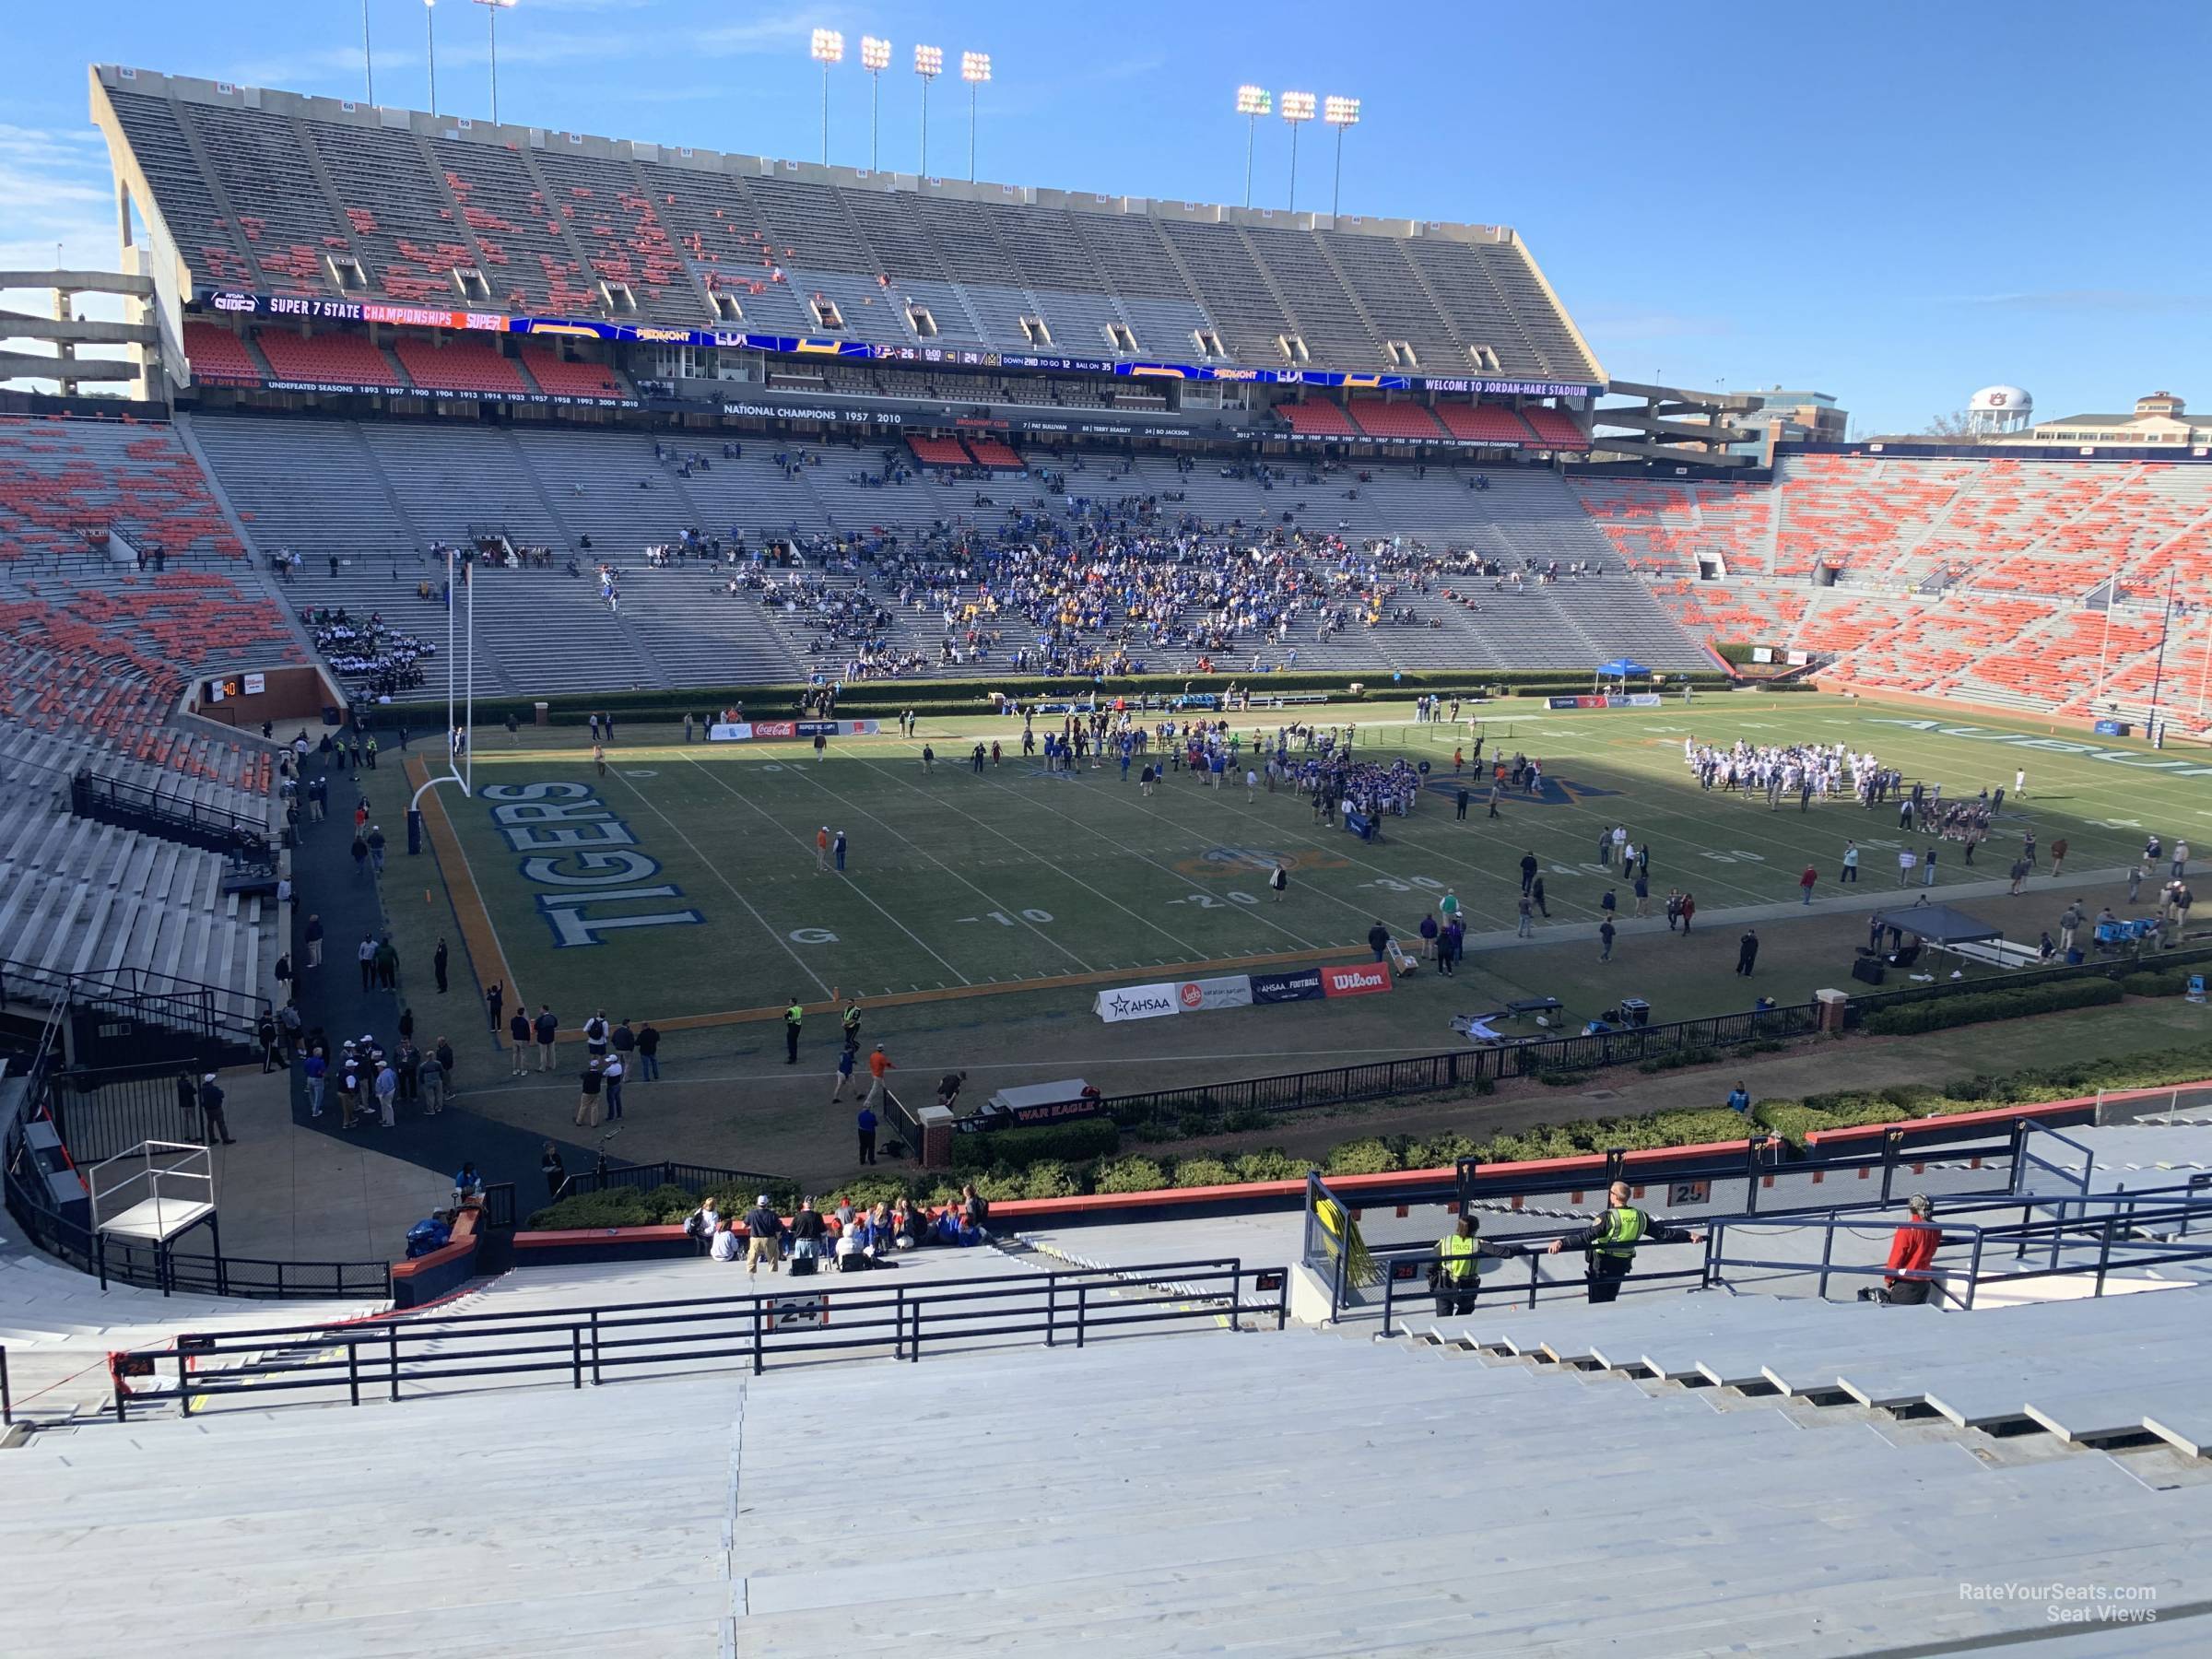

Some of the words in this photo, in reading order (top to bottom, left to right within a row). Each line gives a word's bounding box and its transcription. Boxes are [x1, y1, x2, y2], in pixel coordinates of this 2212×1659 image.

[270, 298, 309, 315] SUPER
[312, 301, 321, 315] 7
[324, 302, 360, 319] STATE
[363, 305, 452, 325] CHAMPIONSHIPS
[636, 328, 690, 342] PIEDMONT
[901, 348, 914, 359] 26
[925, 349, 941, 358] 0:00
[964, 353, 977, 363] 24
[1024, 358, 1038, 366] 2ND
[1062, 360, 1070, 369] 12
[1101, 362, 1112, 371] 35
[1214, 369, 1257, 380] PIEDMONT
[268, 381, 316, 391] UNDEFEATED
[318, 383, 354, 393] SEASONS
[385, 387, 404, 395] 1897
[435, 390, 453, 398] 1904
[460, 391, 477, 399] 1913
[484, 392, 501, 400] 1914
[508, 394, 525, 402] 1932
[531, 394, 548, 403] 1957
[577, 397, 594, 406] 1993
[1425, 379, 1467, 392] WELCOME
[1470, 381, 1482, 392] TO
[1484, 382, 1547, 395] JORDAN-HARE
[1548, 385, 1588, 396] STADIUM
[724, 404, 776, 417] NATIONAL
[777, 407, 836, 420] CHAMPIONS
[845, 411, 869, 422] 1957
[877, 413, 900, 424] 2010
[957, 418, 992, 427] BROADWAY
[222, 682, 236, 696] 40
[477, 782, 707, 949] TIGERS
[1187, 891, 1260, 909] 20
[788, 927, 840, 944] G
[1261, 982, 1286, 993] AHSAA
[1290, 977, 1319, 989] FOOTBALL
[1333, 973, 1382, 990] Wilson
[1131, 997, 1171, 1013] AHSAA
[1018, 1108, 1049, 1121] WAR
[1052, 1100, 1095, 1117] EAGLE
